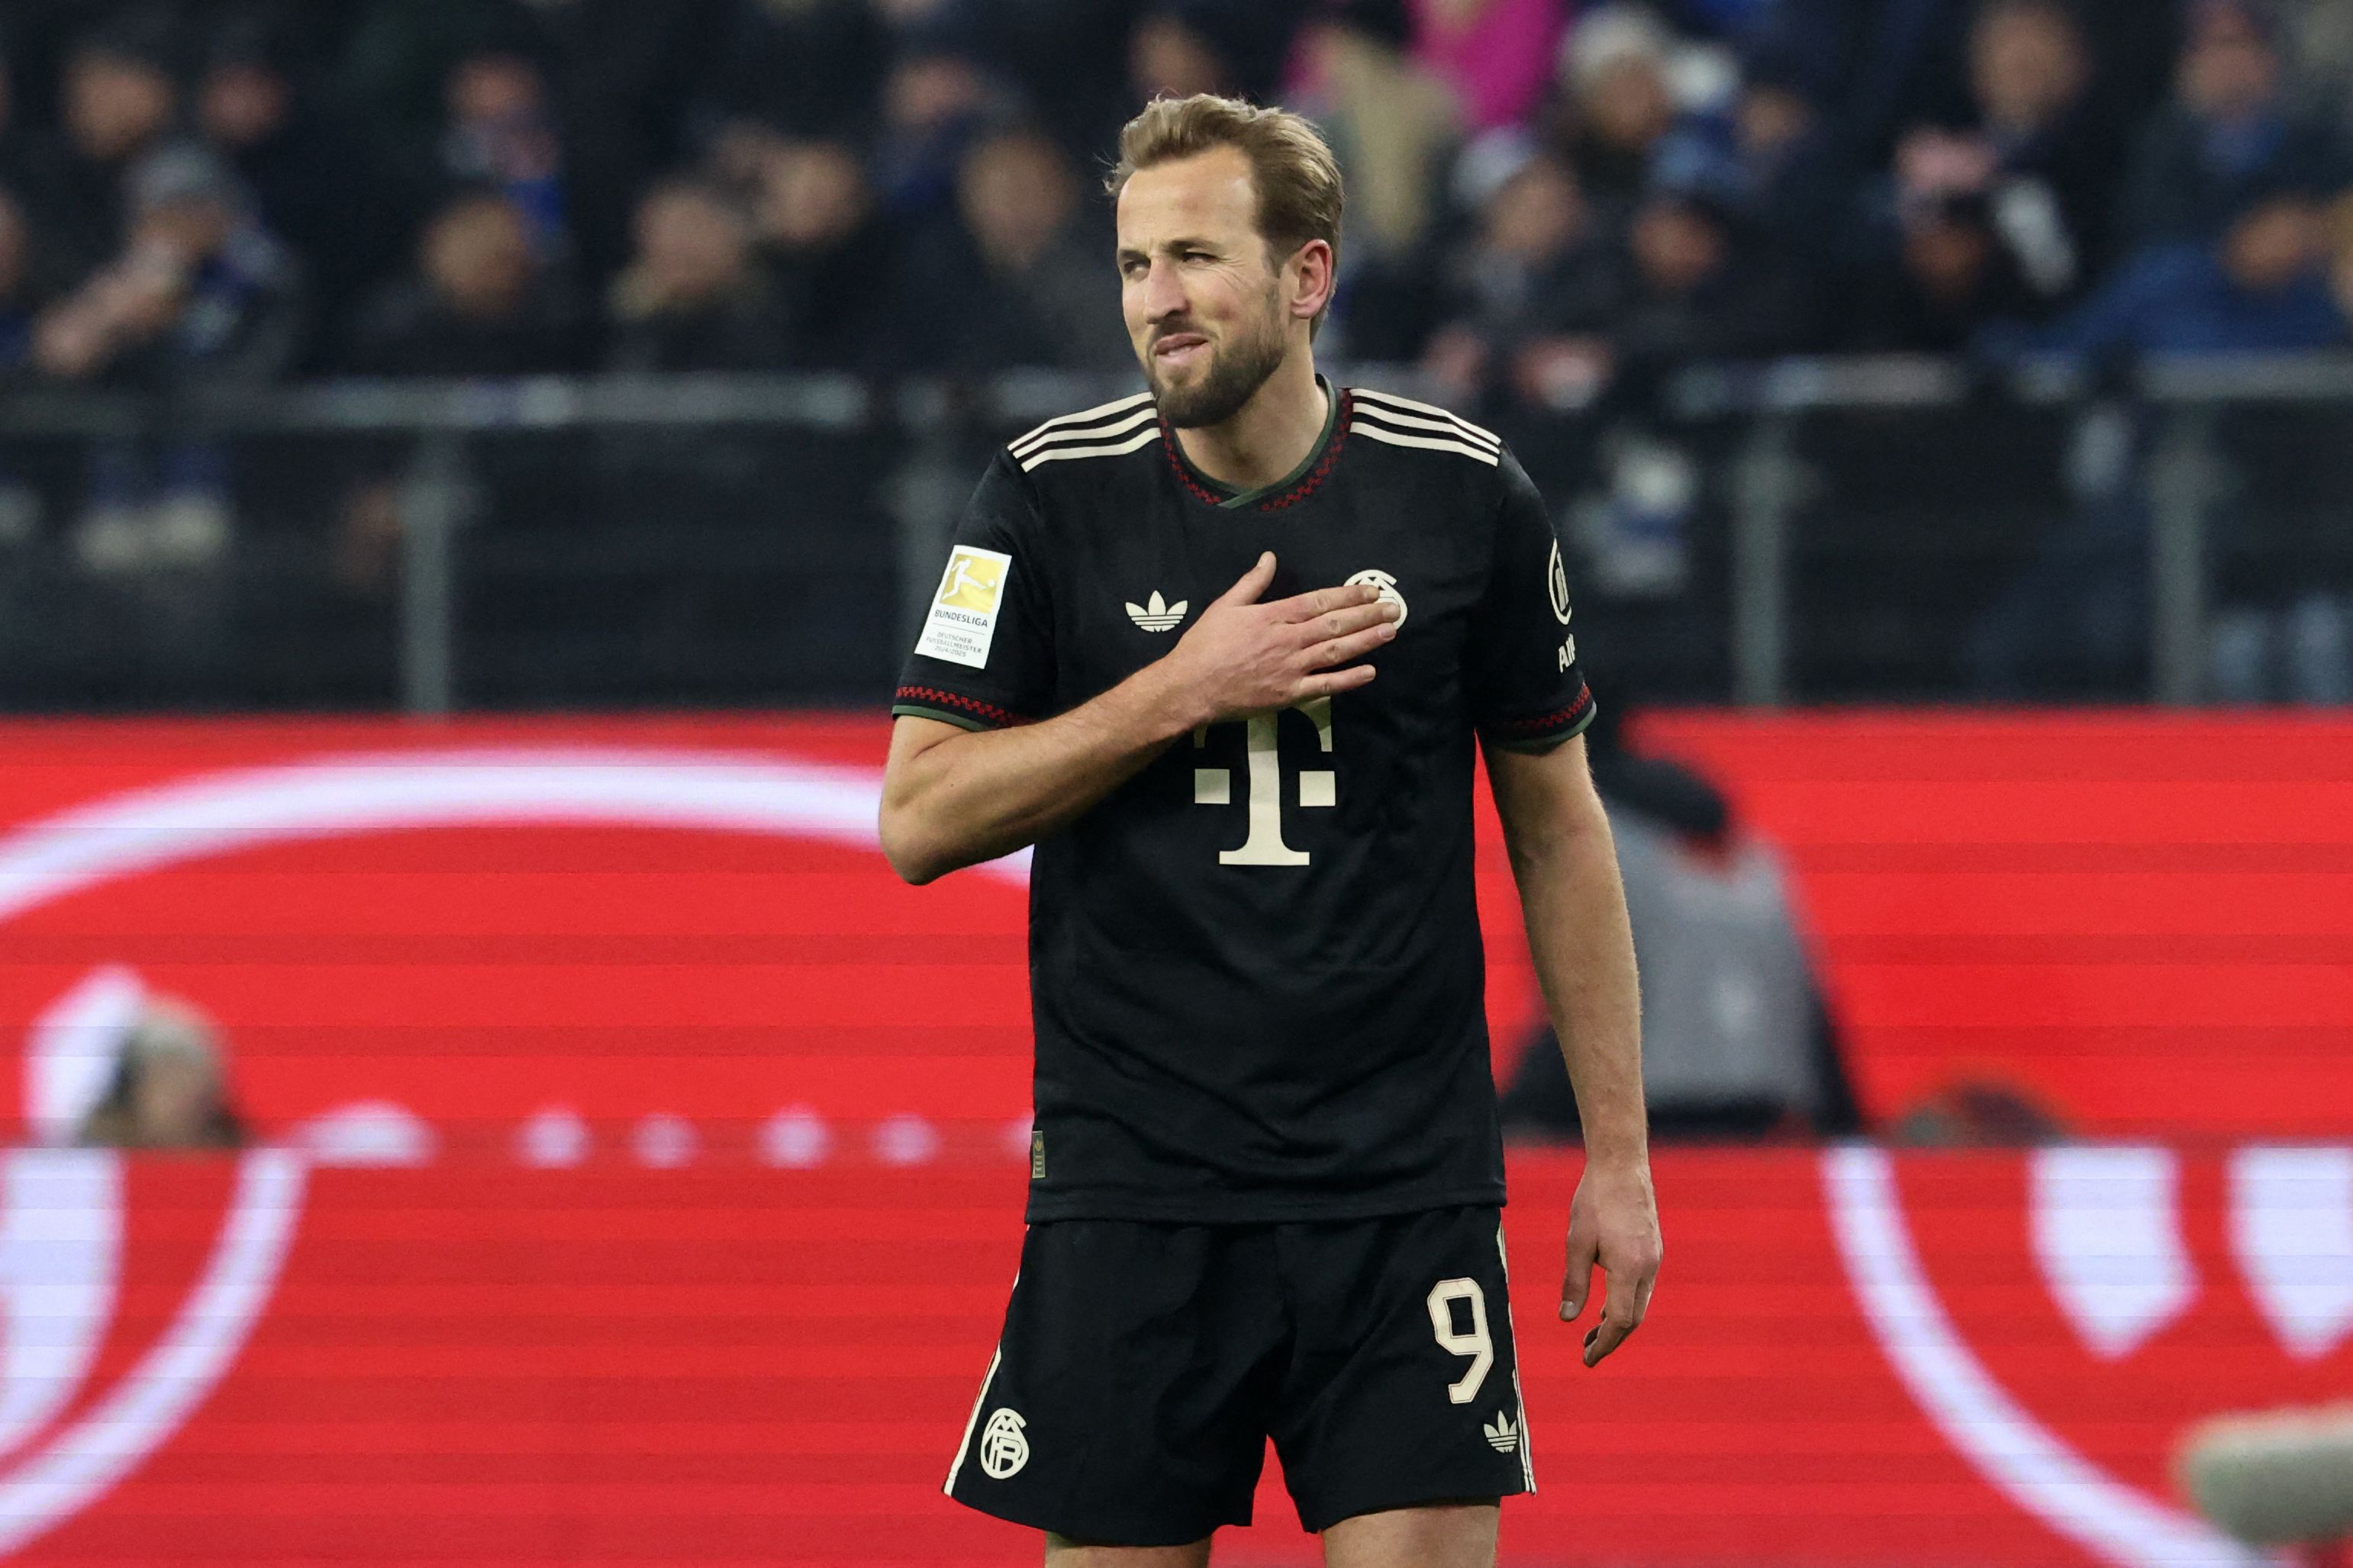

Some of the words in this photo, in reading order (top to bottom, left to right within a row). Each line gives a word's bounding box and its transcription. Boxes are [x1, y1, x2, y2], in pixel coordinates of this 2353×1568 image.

[934, 609, 988, 627] BUNDESLIGA
[936, 632, 972, 644] DEUTSCHER
[1194, 695, 1336, 866] T
[1426, 1277, 1494, 1404] 9
